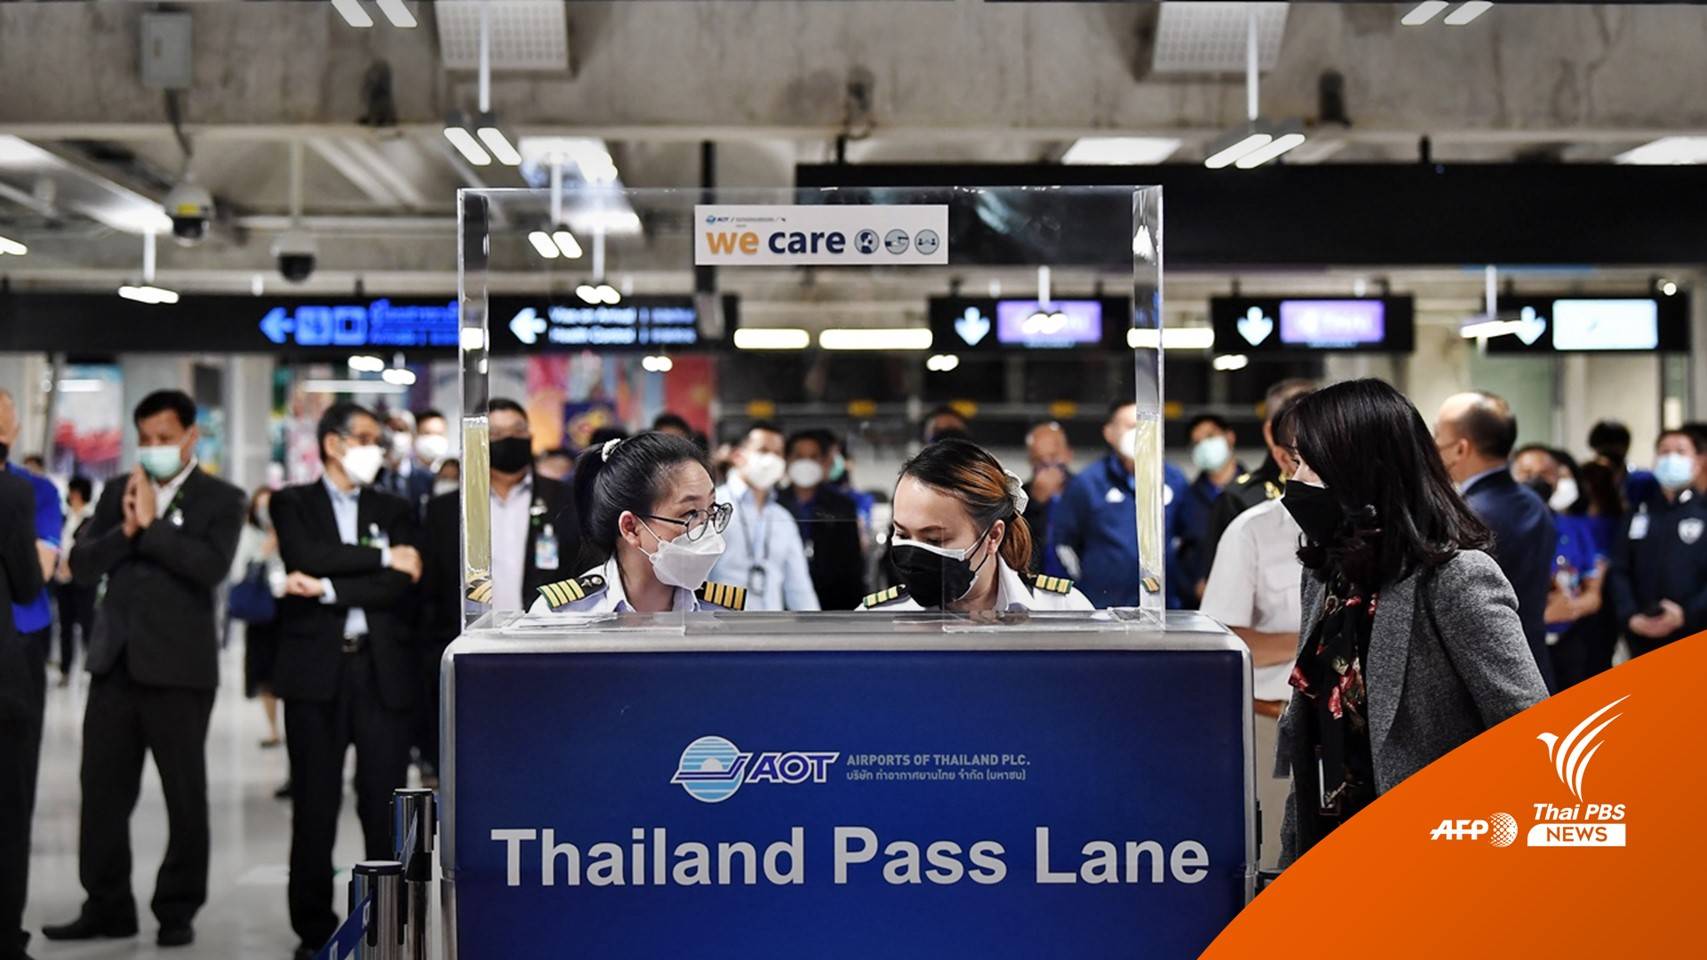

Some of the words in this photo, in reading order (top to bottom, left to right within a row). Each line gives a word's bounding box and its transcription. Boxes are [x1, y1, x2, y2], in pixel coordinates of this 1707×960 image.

[706, 231, 759, 255] we
[768, 231, 846, 255] care
[746, 752, 840, 783] AOT
[846, 753, 911, 766] AIRPORTS
[913, 754, 931, 766] OF
[932, 754, 999, 766] THAILAND
[1001, 754, 1031, 766] PLC.
[490, 827, 804, 886] Thailand
[834, 826, 1007, 885] Pass
[1035, 826, 1209, 884] Lane
